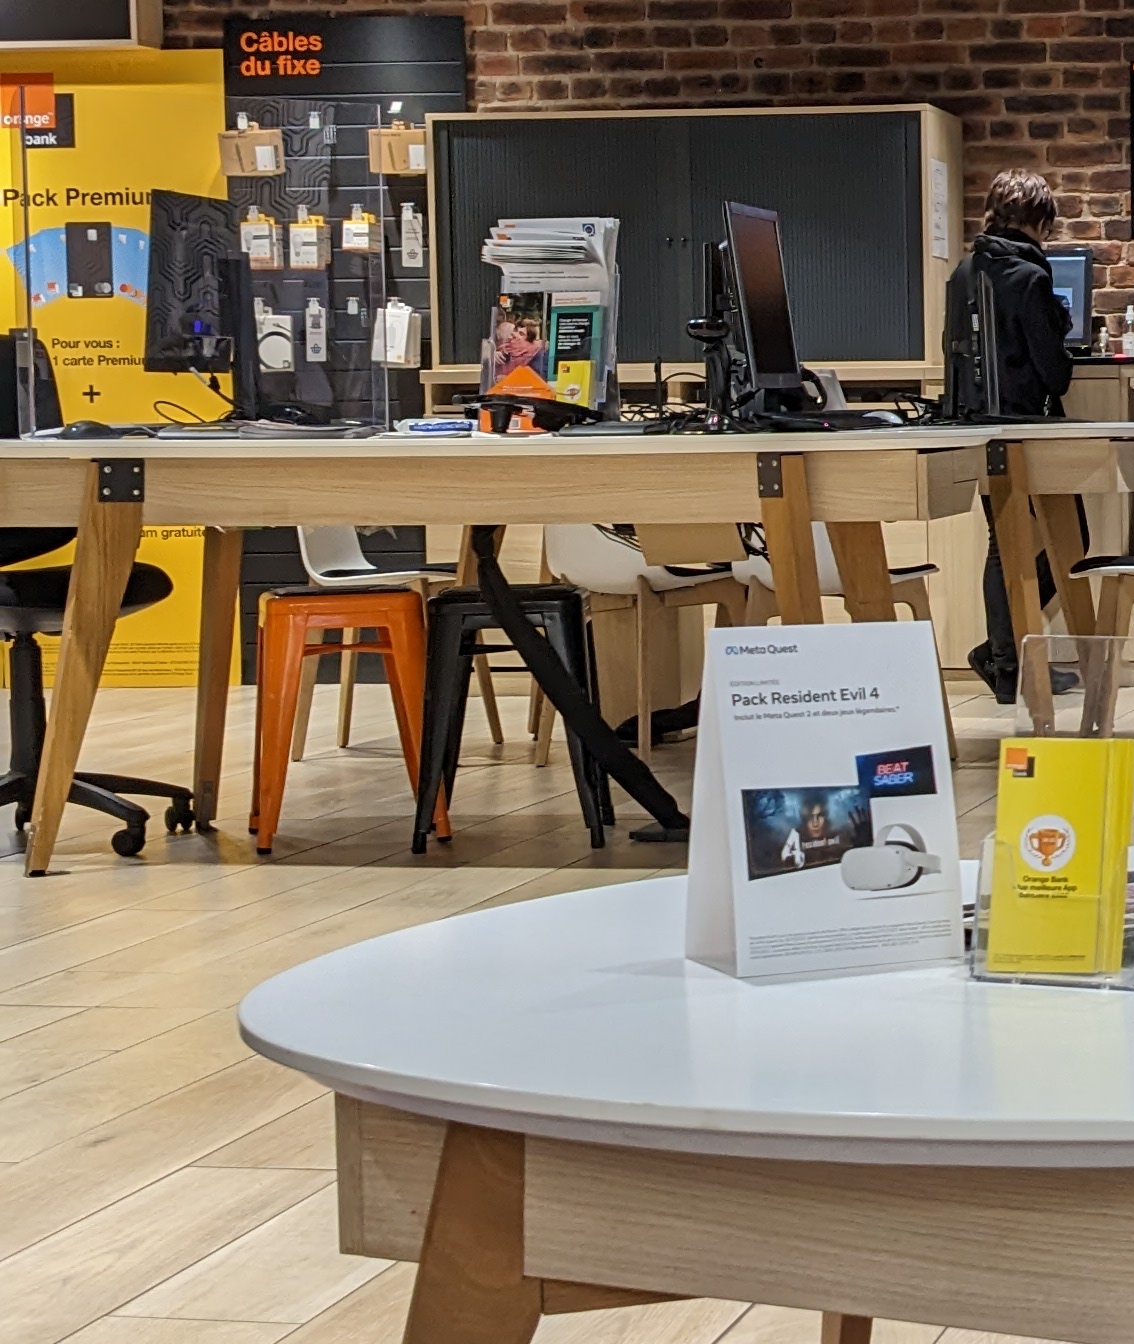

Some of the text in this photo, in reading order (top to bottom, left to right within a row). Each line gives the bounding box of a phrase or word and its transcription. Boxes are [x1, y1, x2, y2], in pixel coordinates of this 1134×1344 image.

[240, 31, 322, 52] Câbles
[241, 55, 321, 76] du fixe
[3, 188, 58, 207] Pack
[52, 338, 80, 349] Pour
[84, 339, 113, 349] vous
[53, 356, 58, 366] 1
[63, 356, 94, 366] carte
[739, 644, 798, 655] Meta Quest
[731, 687, 880, 706] Pack Resident Evil 4
[877, 761, 909, 774] BEAT
[873, 771, 914, 786] SABER
